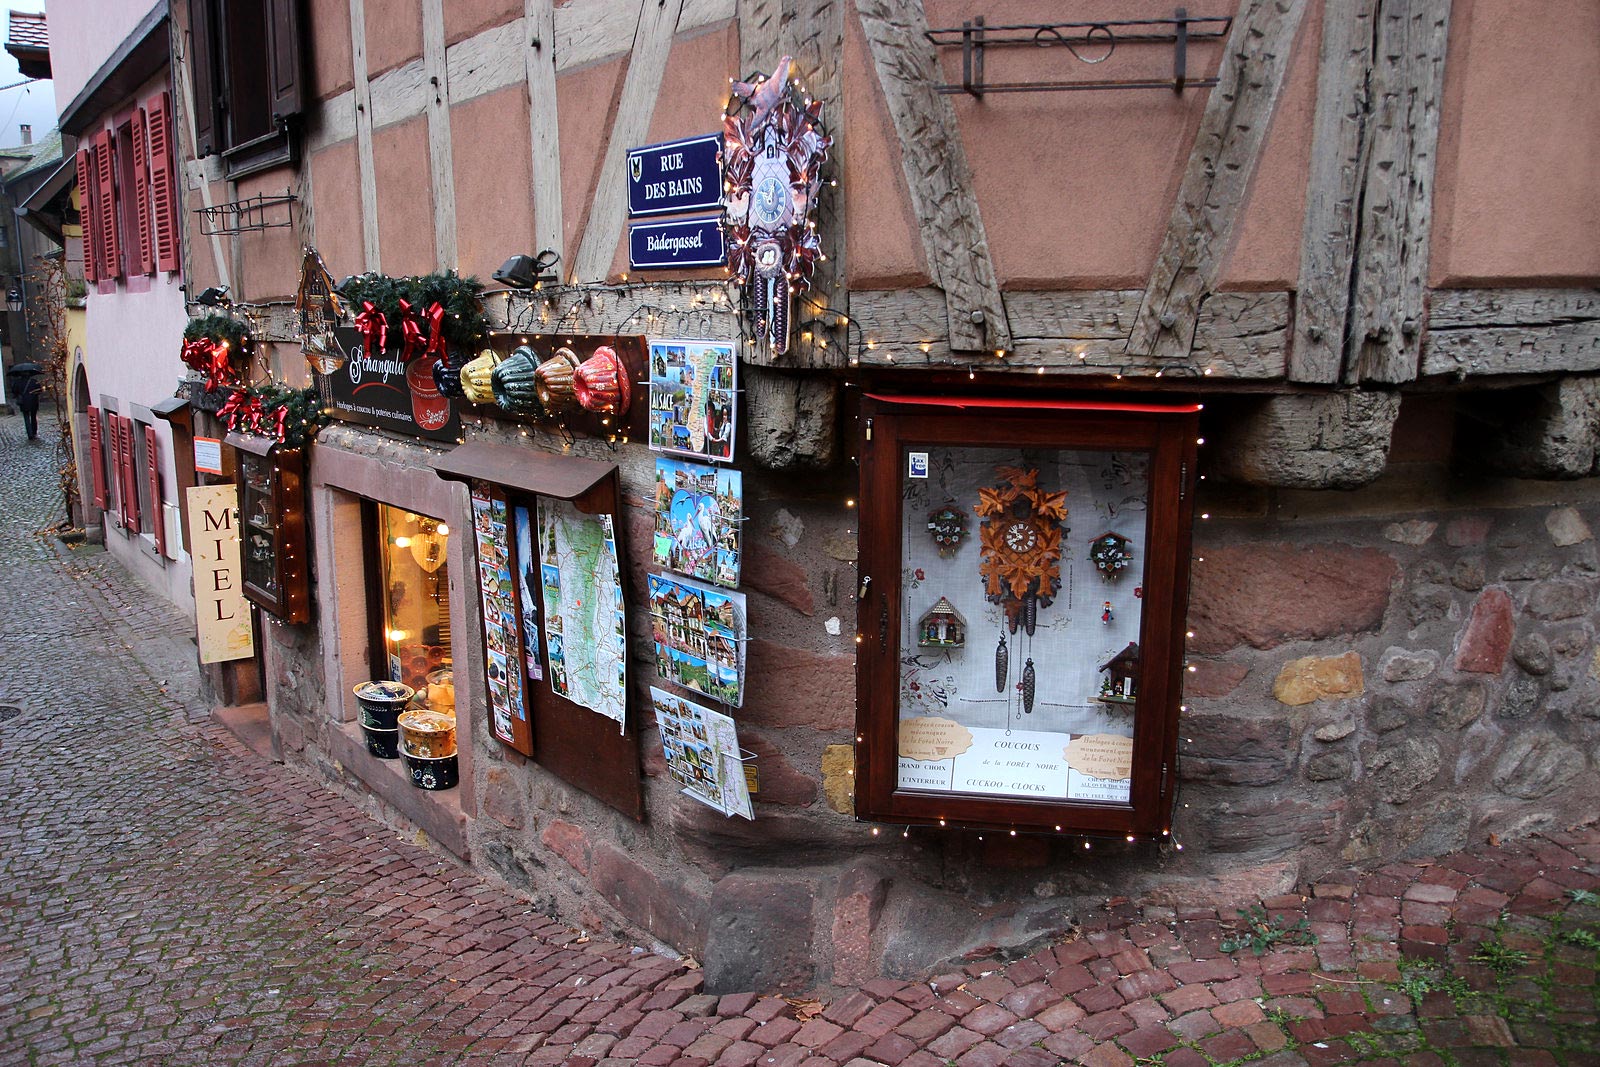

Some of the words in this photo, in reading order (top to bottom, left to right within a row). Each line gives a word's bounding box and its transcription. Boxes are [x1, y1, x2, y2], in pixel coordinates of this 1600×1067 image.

[660, 153, 683, 172] RUE
[645, 181, 666, 199] DES
[668, 177, 703, 197] BAINS
[646, 229, 703, 256] Bàdergassel
[651, 394, 674, 411] ALSACE
[203, 507, 235, 621] MIEL
[994, 740, 1041, 751] COUCOUS
[1006, 760, 1031, 768] FORÊT
[1035, 763, 1060, 771] NOIRE
[966, 779, 1003, 788] CUCKOO
[1011, 782, 1046, 792] CLOCKS
